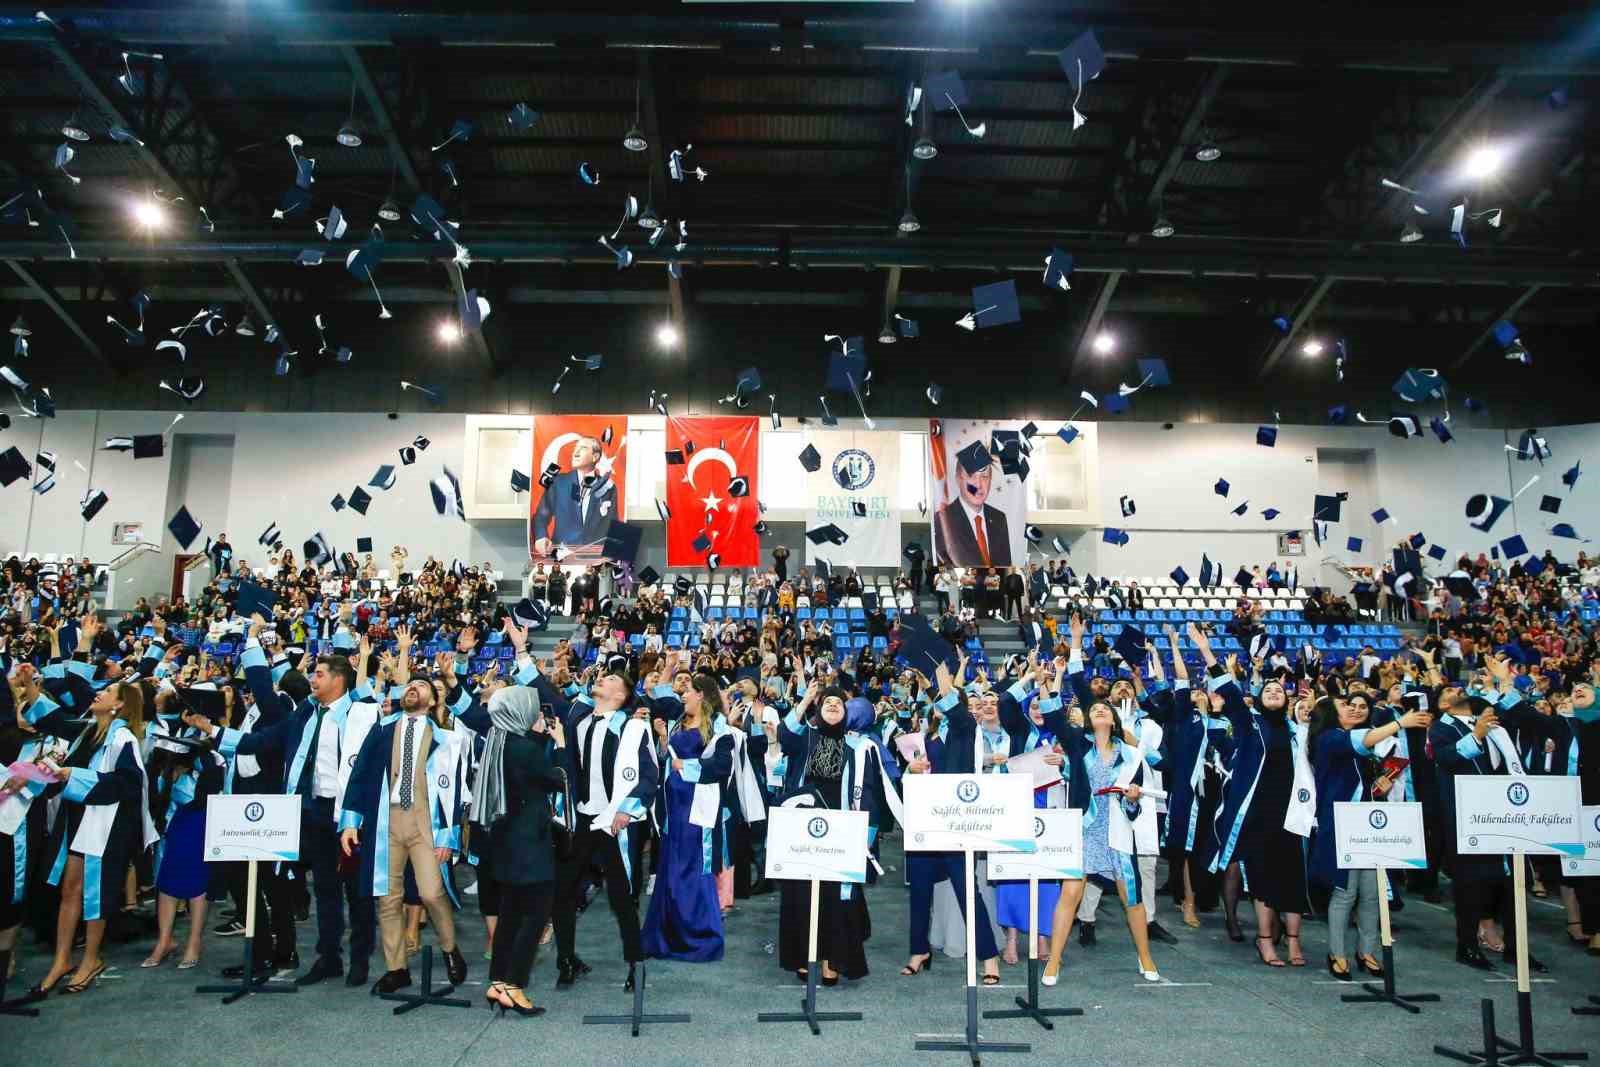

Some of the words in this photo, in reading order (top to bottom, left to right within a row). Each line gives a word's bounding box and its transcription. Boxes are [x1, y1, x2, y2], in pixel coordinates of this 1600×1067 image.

[931, 804, 962, 817] Sağlık
[964, 804, 1005, 815] Bilimleri
[1470, 812, 1529, 826] Mühendislik
[1530, 813, 1573, 826] Fakültesi
[948, 820, 993, 832] Fakültesi
